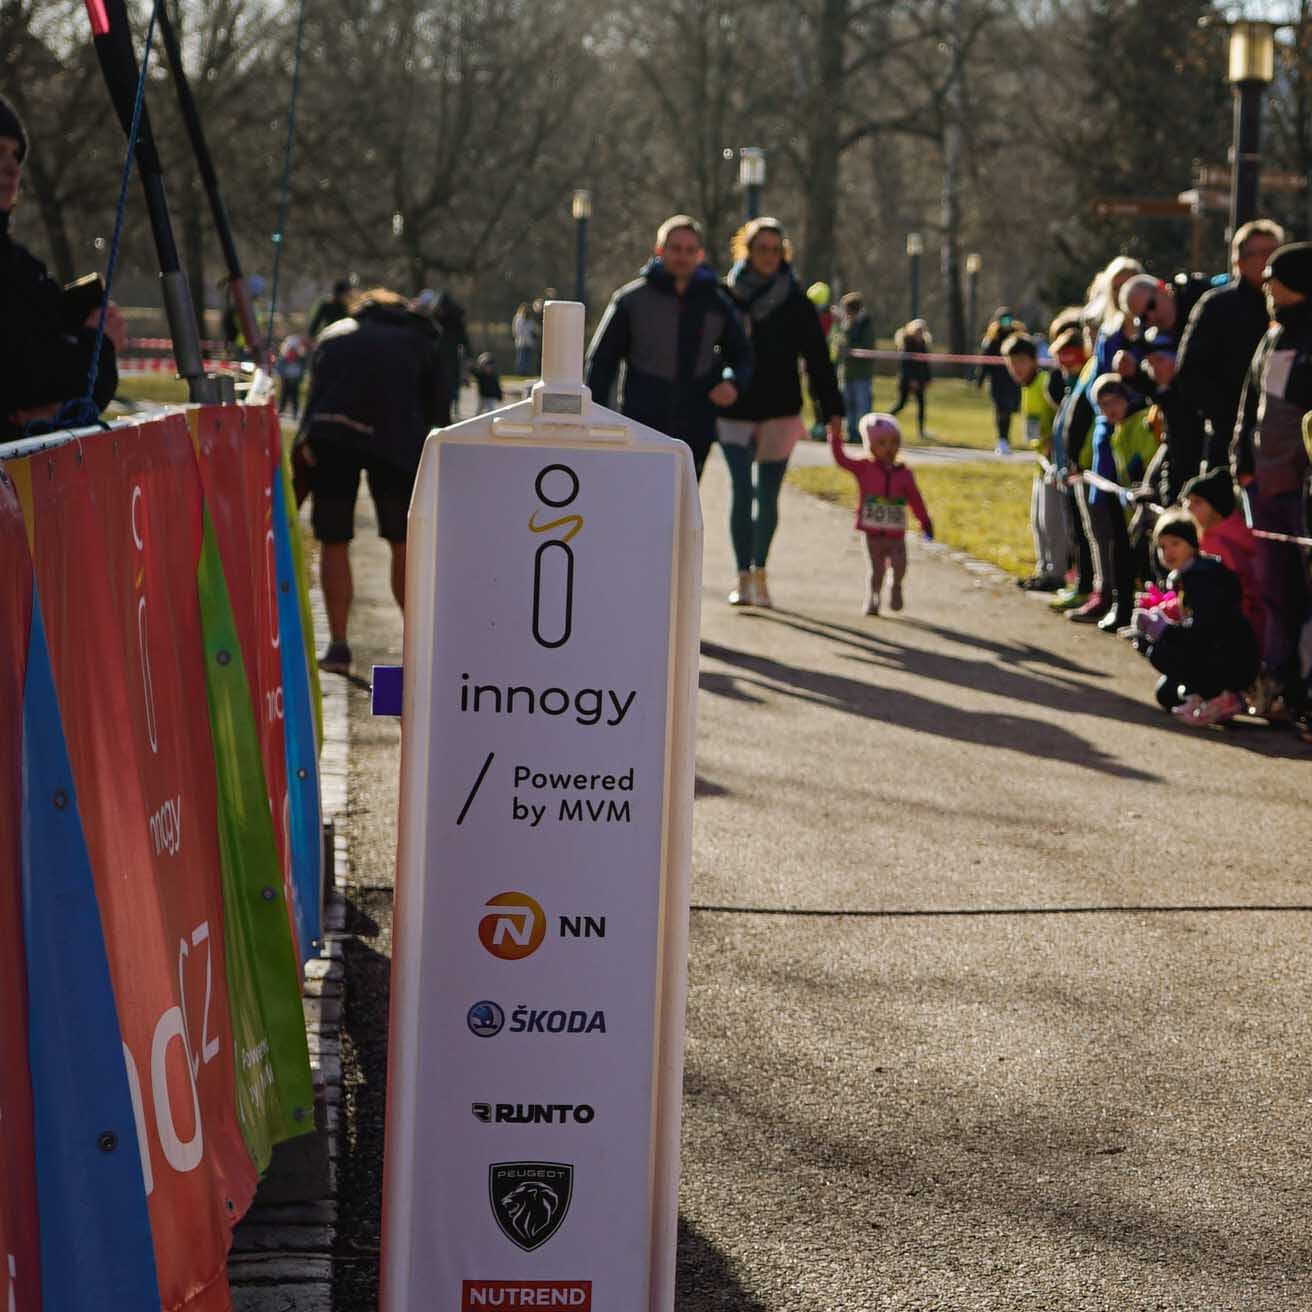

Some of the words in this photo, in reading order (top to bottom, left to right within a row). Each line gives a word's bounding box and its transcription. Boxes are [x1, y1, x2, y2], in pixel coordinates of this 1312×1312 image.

[459, 672, 637, 726] innogy
[513, 765, 636, 792] Powered
[511, 797, 547, 827] by
[557, 799, 632, 824] MVM
[559, 916, 607, 939] NN
[509, 1004, 608, 1035] ŠKODA
[495, 1102, 596, 1125] RUNTO
[497, 1169, 567, 1180] PEUGEOT
[469, 1287, 587, 1308] NUTREND
